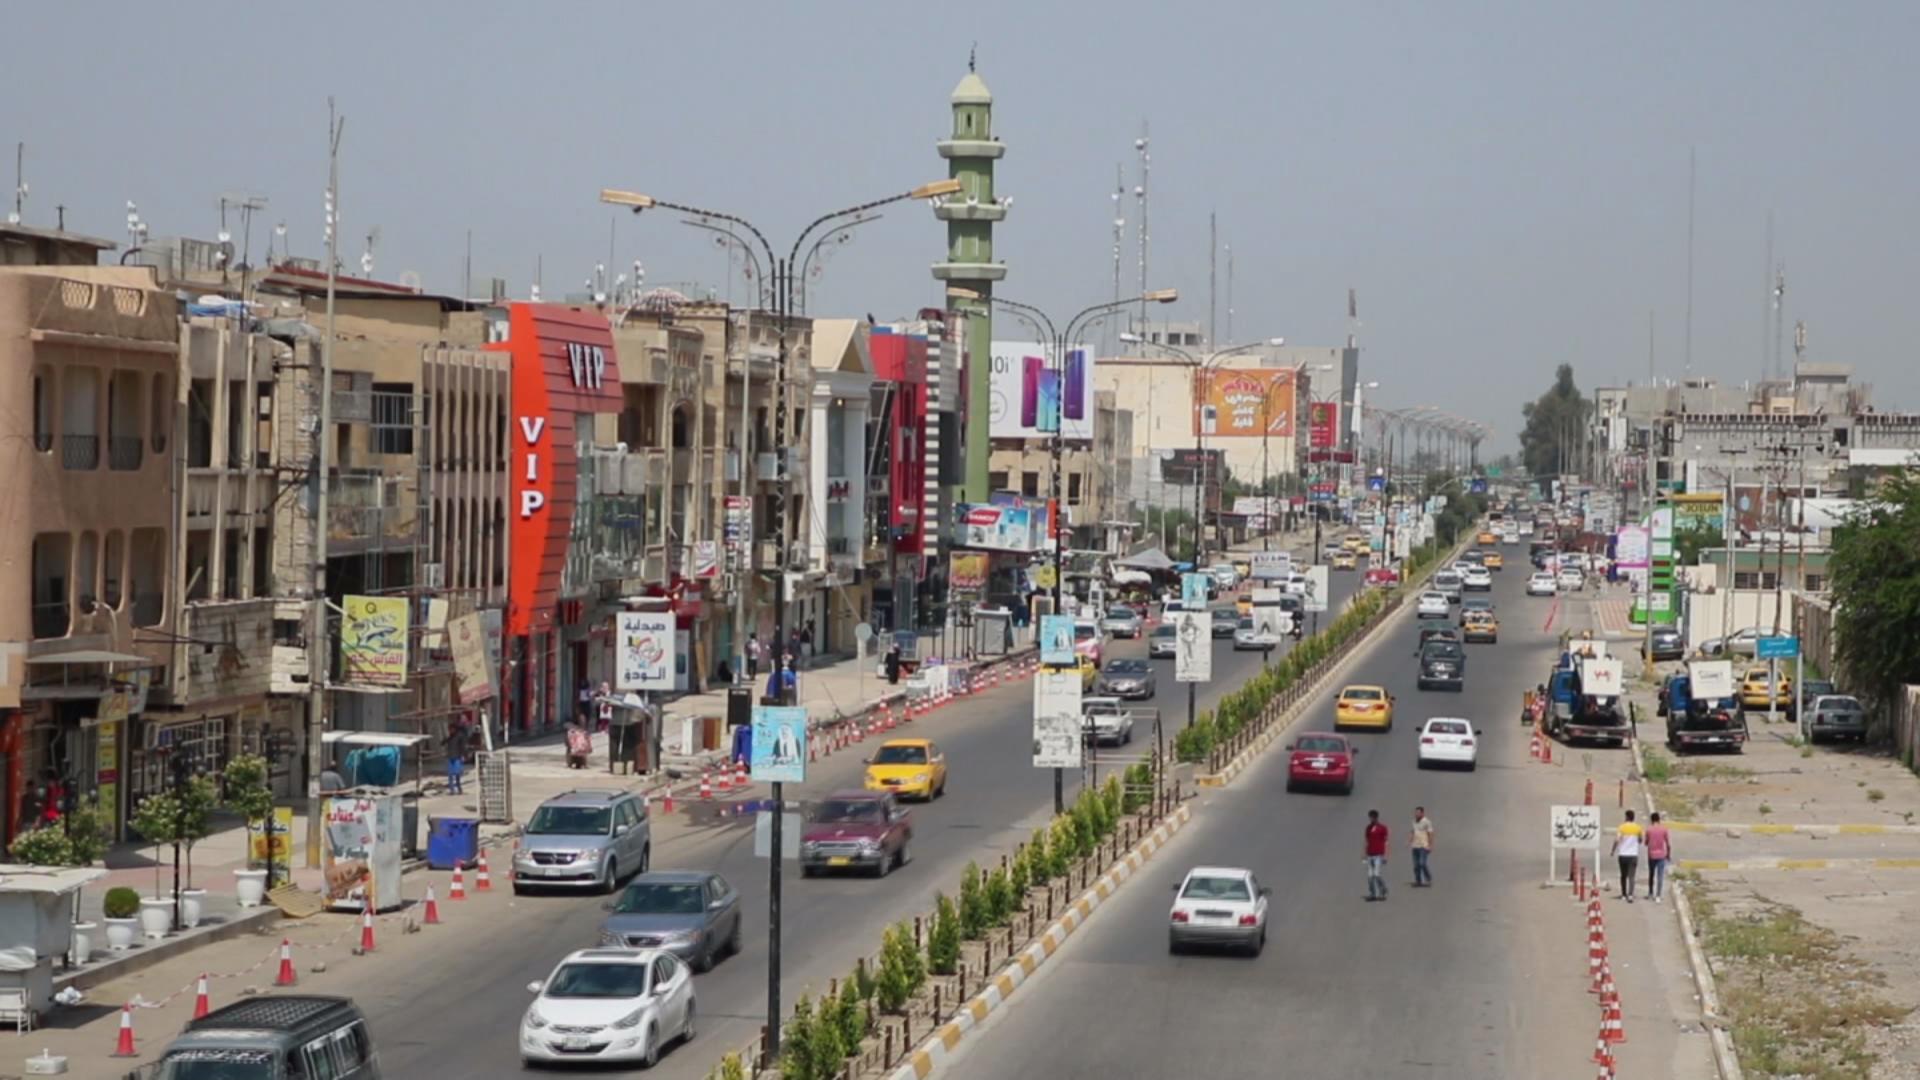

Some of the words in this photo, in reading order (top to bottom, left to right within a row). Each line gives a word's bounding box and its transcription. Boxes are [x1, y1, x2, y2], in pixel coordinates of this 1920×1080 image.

[568, 342, 605, 389] VIP
[520, 416, 545, 518] VIP
[624, 616, 666, 634] صيدلية
